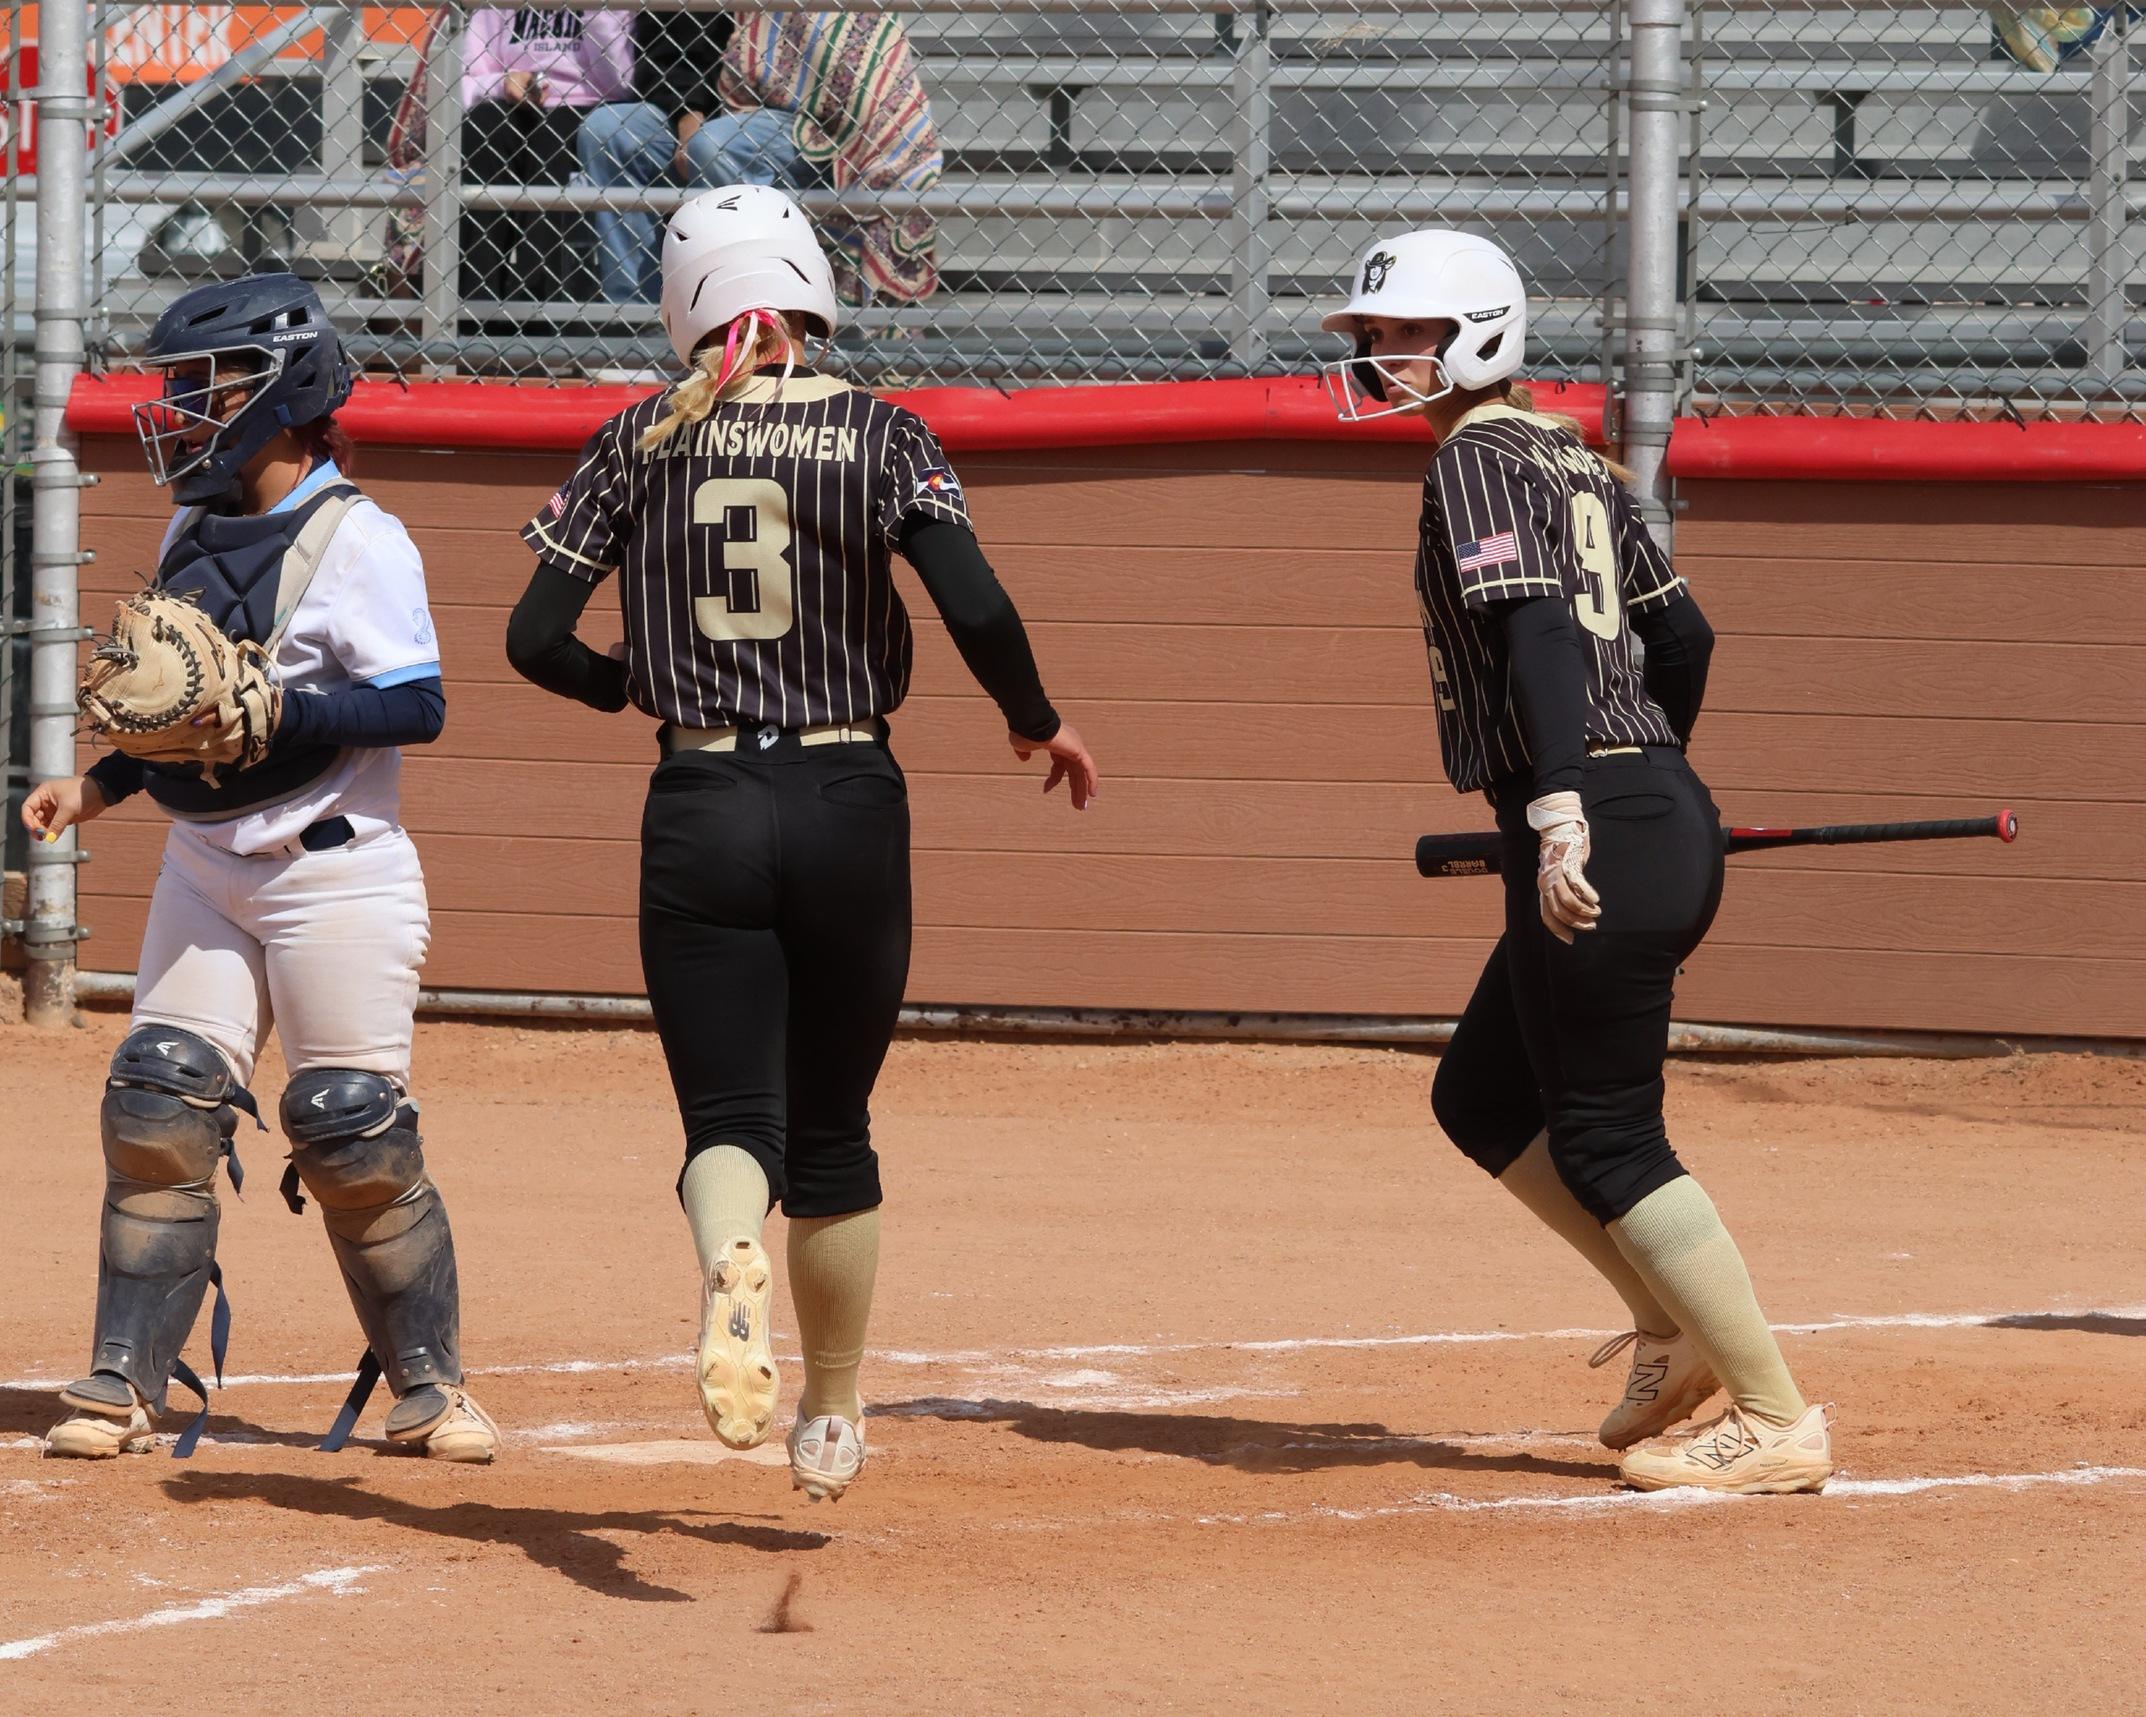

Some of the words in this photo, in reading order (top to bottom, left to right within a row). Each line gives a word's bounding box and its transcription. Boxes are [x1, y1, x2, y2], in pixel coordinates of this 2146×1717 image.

[534, 42, 581, 52] ISLAND
[1471, 309, 1504, 319] EASTON
[273, 331, 318, 342] EASTON
[693, 478, 794, 641] 3
[1571, 490, 1620, 641] 9
